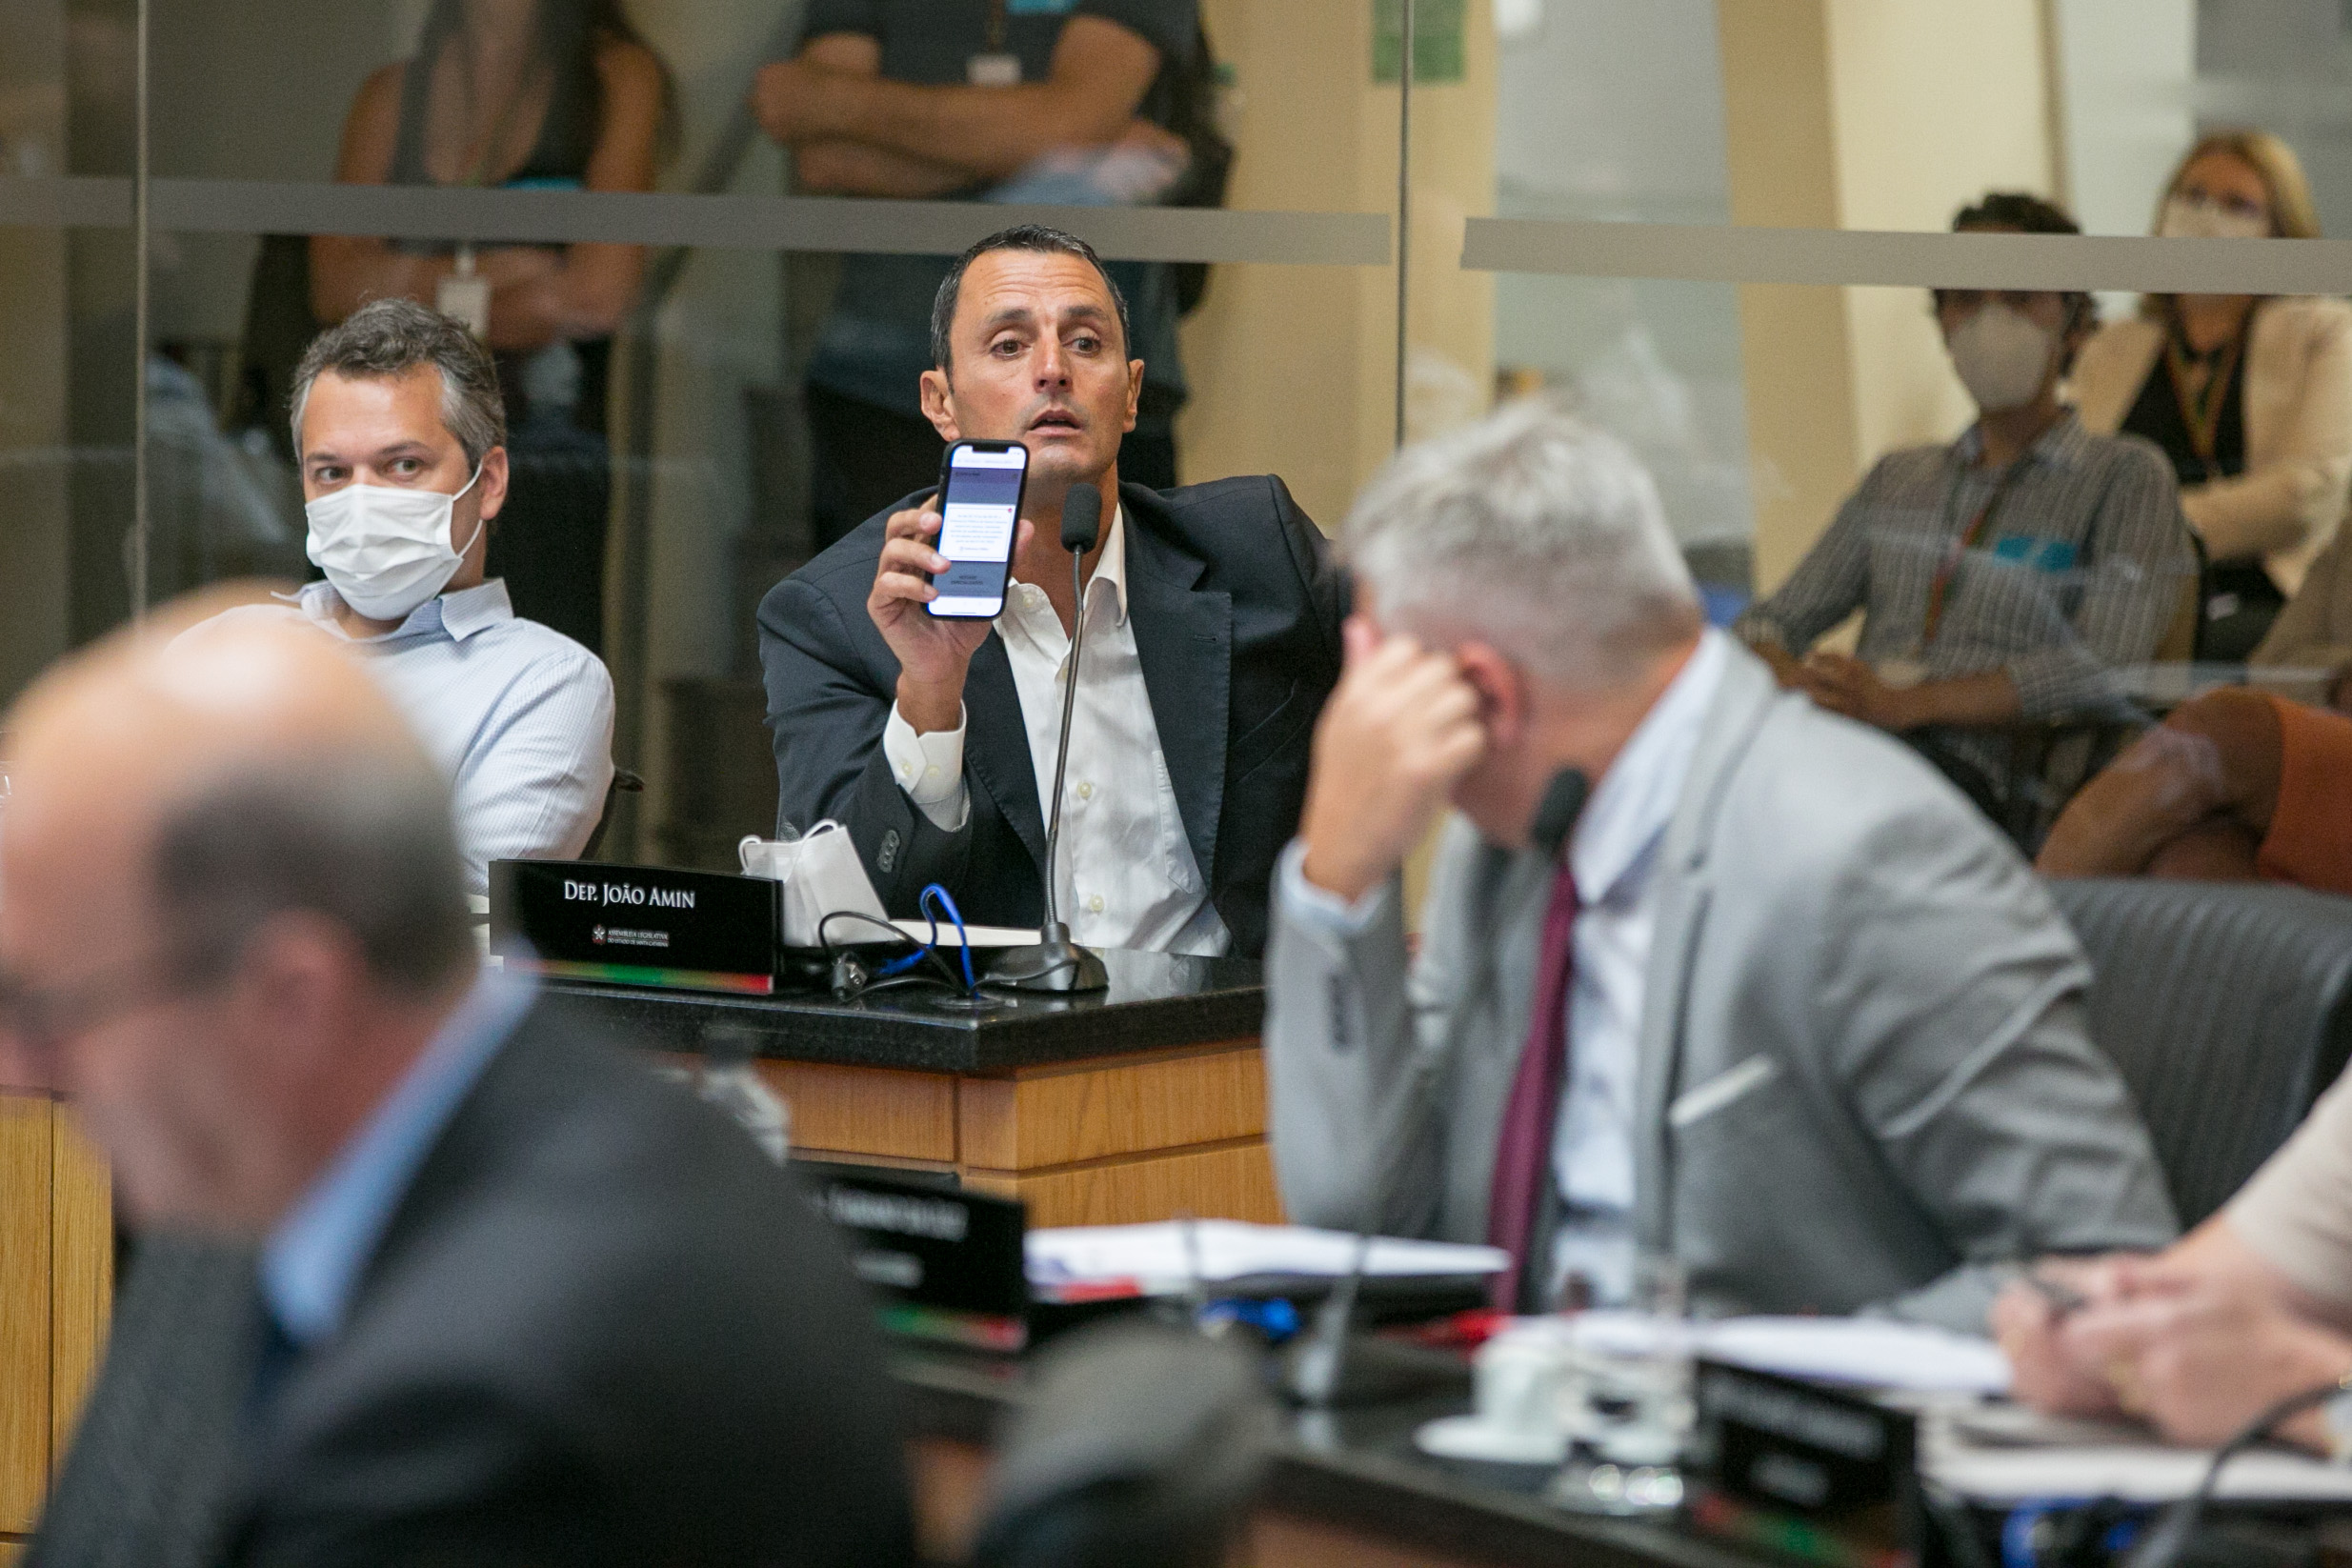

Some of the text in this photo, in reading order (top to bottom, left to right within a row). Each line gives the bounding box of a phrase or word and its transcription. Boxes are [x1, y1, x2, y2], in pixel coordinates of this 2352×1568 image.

[564, 880, 695, 909] DEP. JOÃO AMIN
